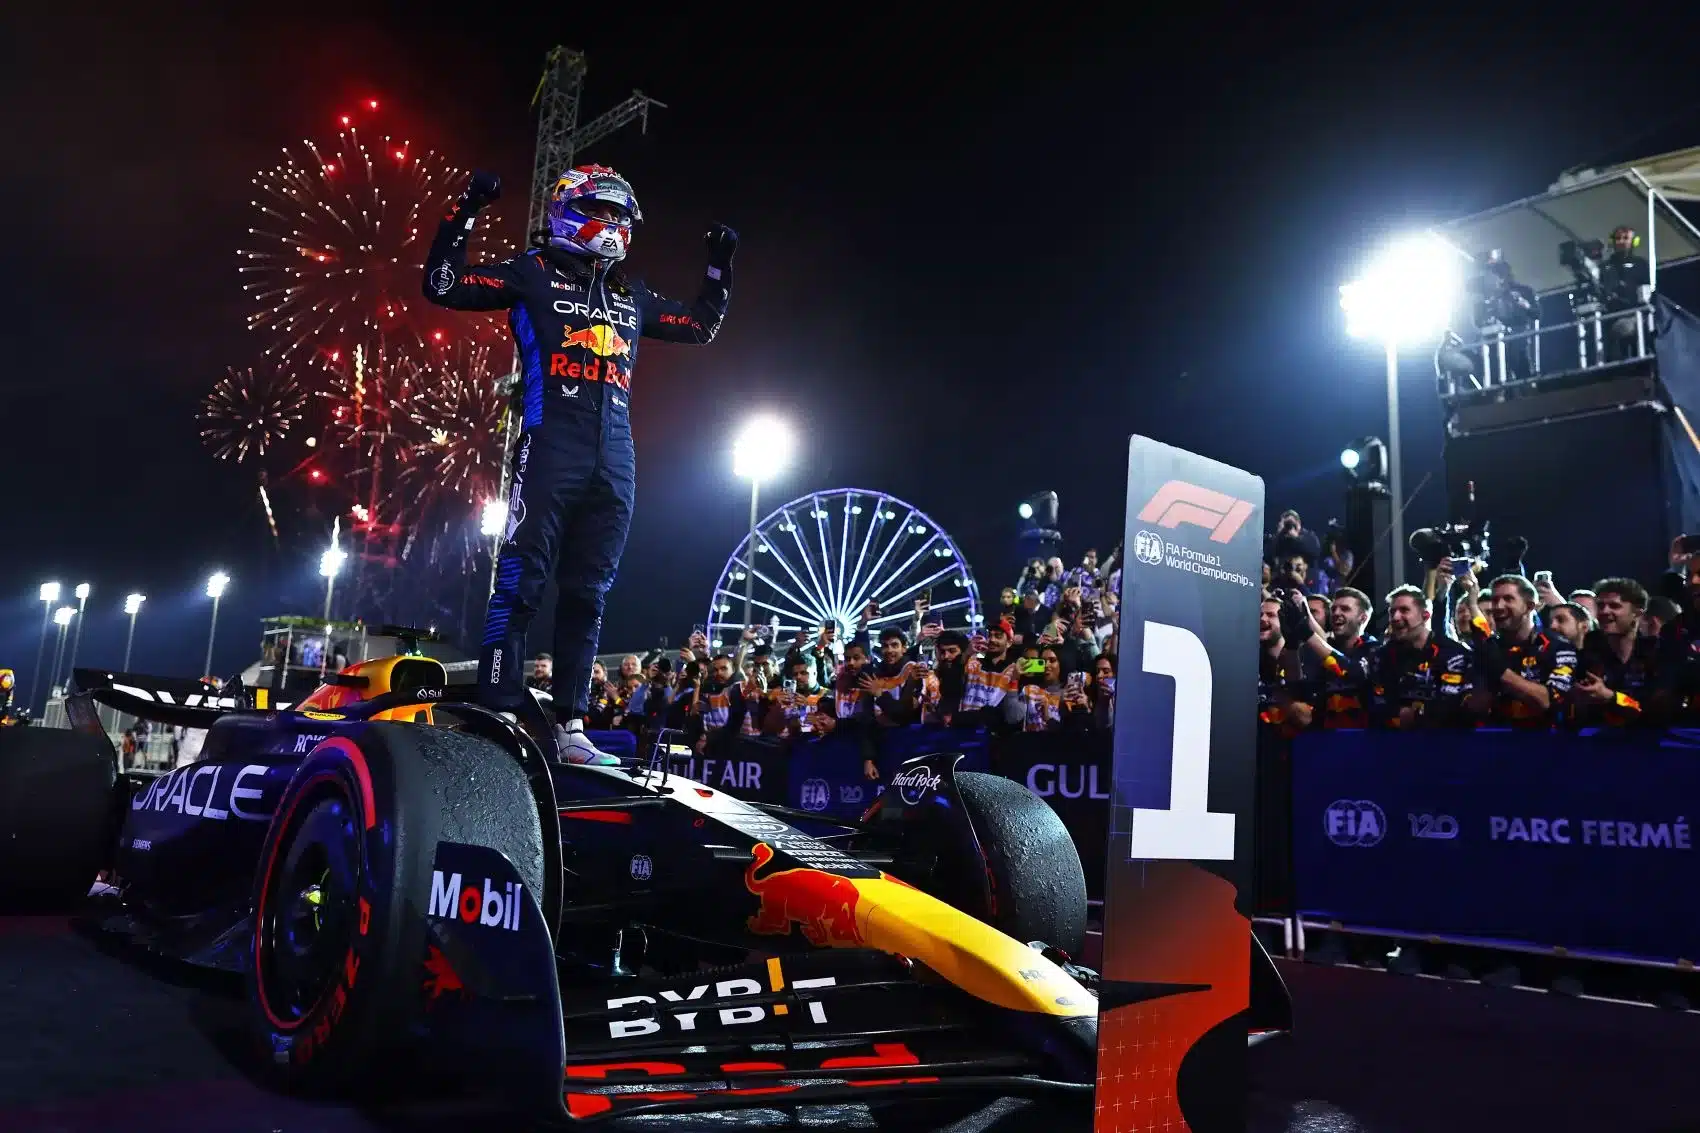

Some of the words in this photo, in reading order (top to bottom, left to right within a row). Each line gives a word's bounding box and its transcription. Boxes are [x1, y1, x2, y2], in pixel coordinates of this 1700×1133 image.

[551, 281, 575, 291] Mobil
[553, 300, 636, 330] ORACLE
[550, 353, 600, 381] Red
[604, 360, 631, 392] Bull
[1165, 542, 1180, 556] FIA
[1181, 546, 1215, 565] Formula
[1216, 555, 1221, 566] 1
[1165, 555, 1191, 572] World
[1192, 562, 1249, 586] Championship
[428, 689, 443, 698] Sui
[1131, 621, 1235, 861] 1
[722, 760, 762, 789] AIR
[891, 773, 916, 787] Hard
[132, 764, 273, 821] ORACLE
[1408, 813, 1459, 839] 120
[1489, 816, 1571, 844] PARC
[1582, 816, 1692, 849] FERMÉ
[428, 870, 523, 931] Mobil
[606, 957, 836, 1039] BYBIT
